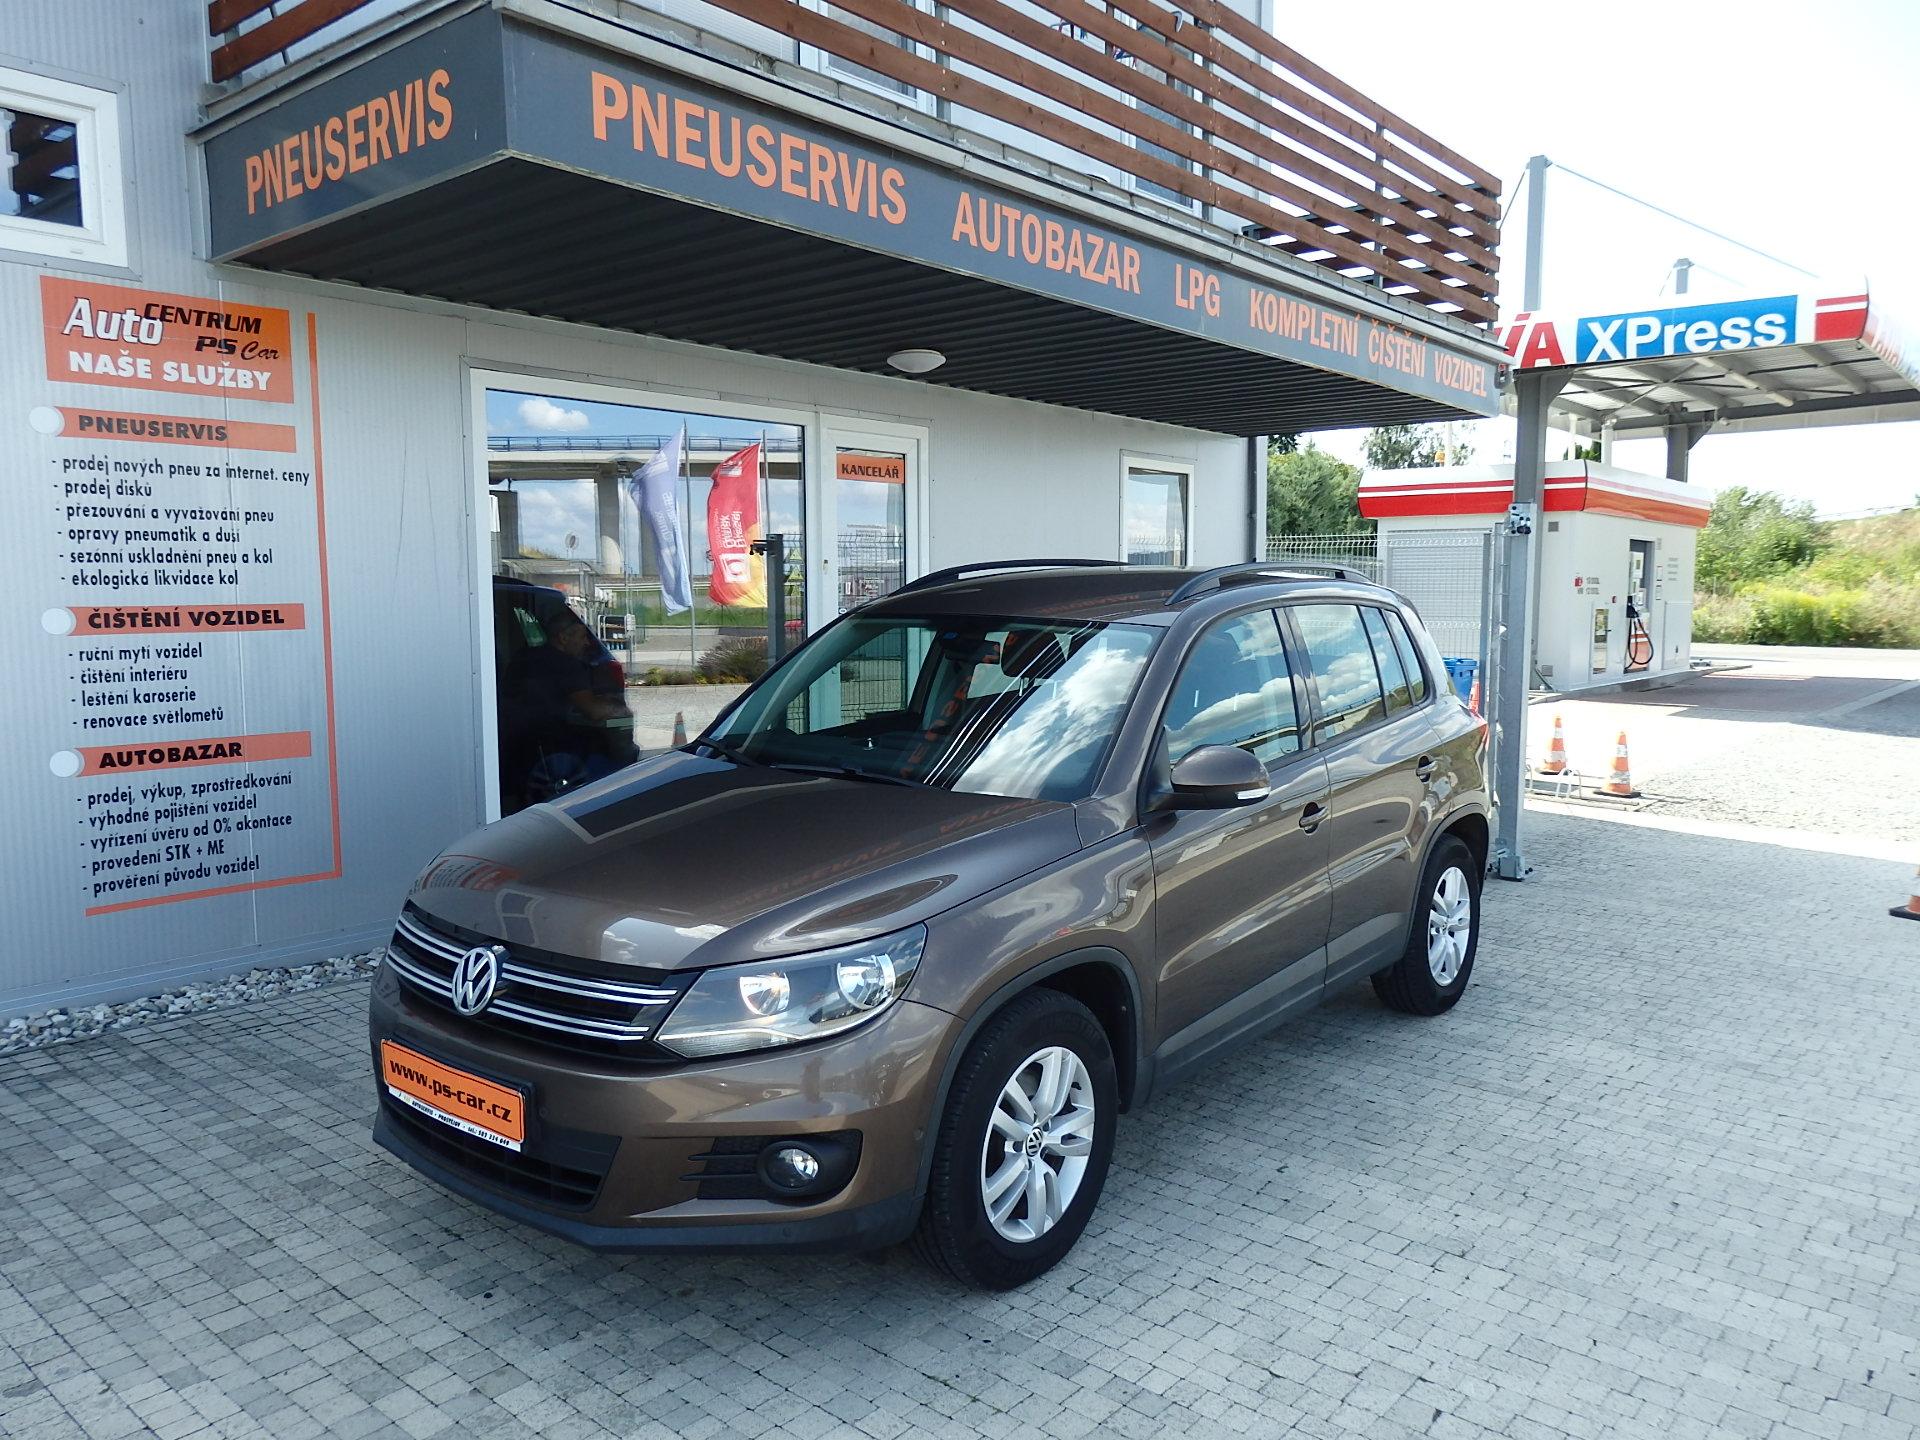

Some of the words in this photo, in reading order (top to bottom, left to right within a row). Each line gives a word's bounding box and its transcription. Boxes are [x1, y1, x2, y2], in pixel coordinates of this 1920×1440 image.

[246, 68, 453, 214] PNEUSERVIS
[591, 70, 907, 225] PNEUSERVIS
[951, 191, 1140, 294] AUTOBAZAR
[1174, 263, 1220, 317] LPG
[1250, 288, 1360, 357] KOMPLETNÍ
[1368, 318, 1426, 379] ČIŠTĚNÍ
[1434, 350, 1488, 398] VOZIDEL
[62, 296, 163, 345] Auto
[144, 302, 262, 334] CENTRUM
[1587, 312, 1787, 362] XPress
[241, 341, 280, 361] Car
[69, 350, 151, 379] NAŠE
[163, 361, 271, 390] SLUŽBY
[79, 414, 228, 441] PNEUSERVIS
[63, 458, 109, 475] prodej
[114, 458, 163, 477] nových
[169, 464, 200, 478] pneu
[206, 466, 220, 477] za
[282, 470, 310, 486] ceny
[842, 464, 898, 478] KANCELÁŘ
[65, 478, 110, 499] prodej
[66, 504, 146, 521] přezouvání
[152, 508, 158, 519] a
[165, 505, 240, 523] vyvažování
[245, 511, 274, 524] pneu
[68, 529, 118, 544] opravy
[125, 526, 196, 544] pneumatik
[203, 531, 210, 542] a
[216, 527, 240, 542] duší
[70, 549, 122, 564] sezónní
[129, 548, 201, 564] uskladnění
[206, 552, 236, 566] pneu
[242, 553, 249, 564] a
[254, 549, 272, 564] kol
[72, 569, 148, 589] ekologická
[154, 570, 214, 586] likvidace
[218, 569, 238, 586] kol
[88, 606, 180, 629] ČIŠTĚNÍ
[188, 609, 284, 626] VOZIDEL
[80, 646, 114, 661] ruční
[119, 645, 150, 663] mytí
[156, 642, 202, 658] vozidel
[81, 668, 125, 684] čištění
[130, 666, 187, 682] interiéru
[82, 689, 128, 706] leštění
[134, 686, 196, 703] karoserie
[84, 714, 147, 729] renovace
[153, 706, 224, 724] světlometů
[100, 742, 242, 768] AUTOBAZAR
[88, 786, 135, 808] prodej,
[141, 782, 186, 802] výkup,
[191, 770, 292, 794] zprostředkování
[90, 808, 149, 830] výhodné
[155, 800, 208, 823] pojištění
[213, 794, 257, 812] vozidel
[91, 829, 147, 852] vyřízení
[152, 826, 188, 842] úvěru
[194, 820, 208, 836] od
[214, 818, 232, 833] 0%
[236, 814, 292, 831] akontace
[92, 849, 161, 876] provedení
[166, 844, 190, 861] STK
[208, 839, 224, 855] ME
[94, 870, 160, 897] prověření
[164, 863, 210, 886] původu
[216, 855, 260, 874] vozidel
[390, 1060, 512, 1123] www.ps-car.cz
